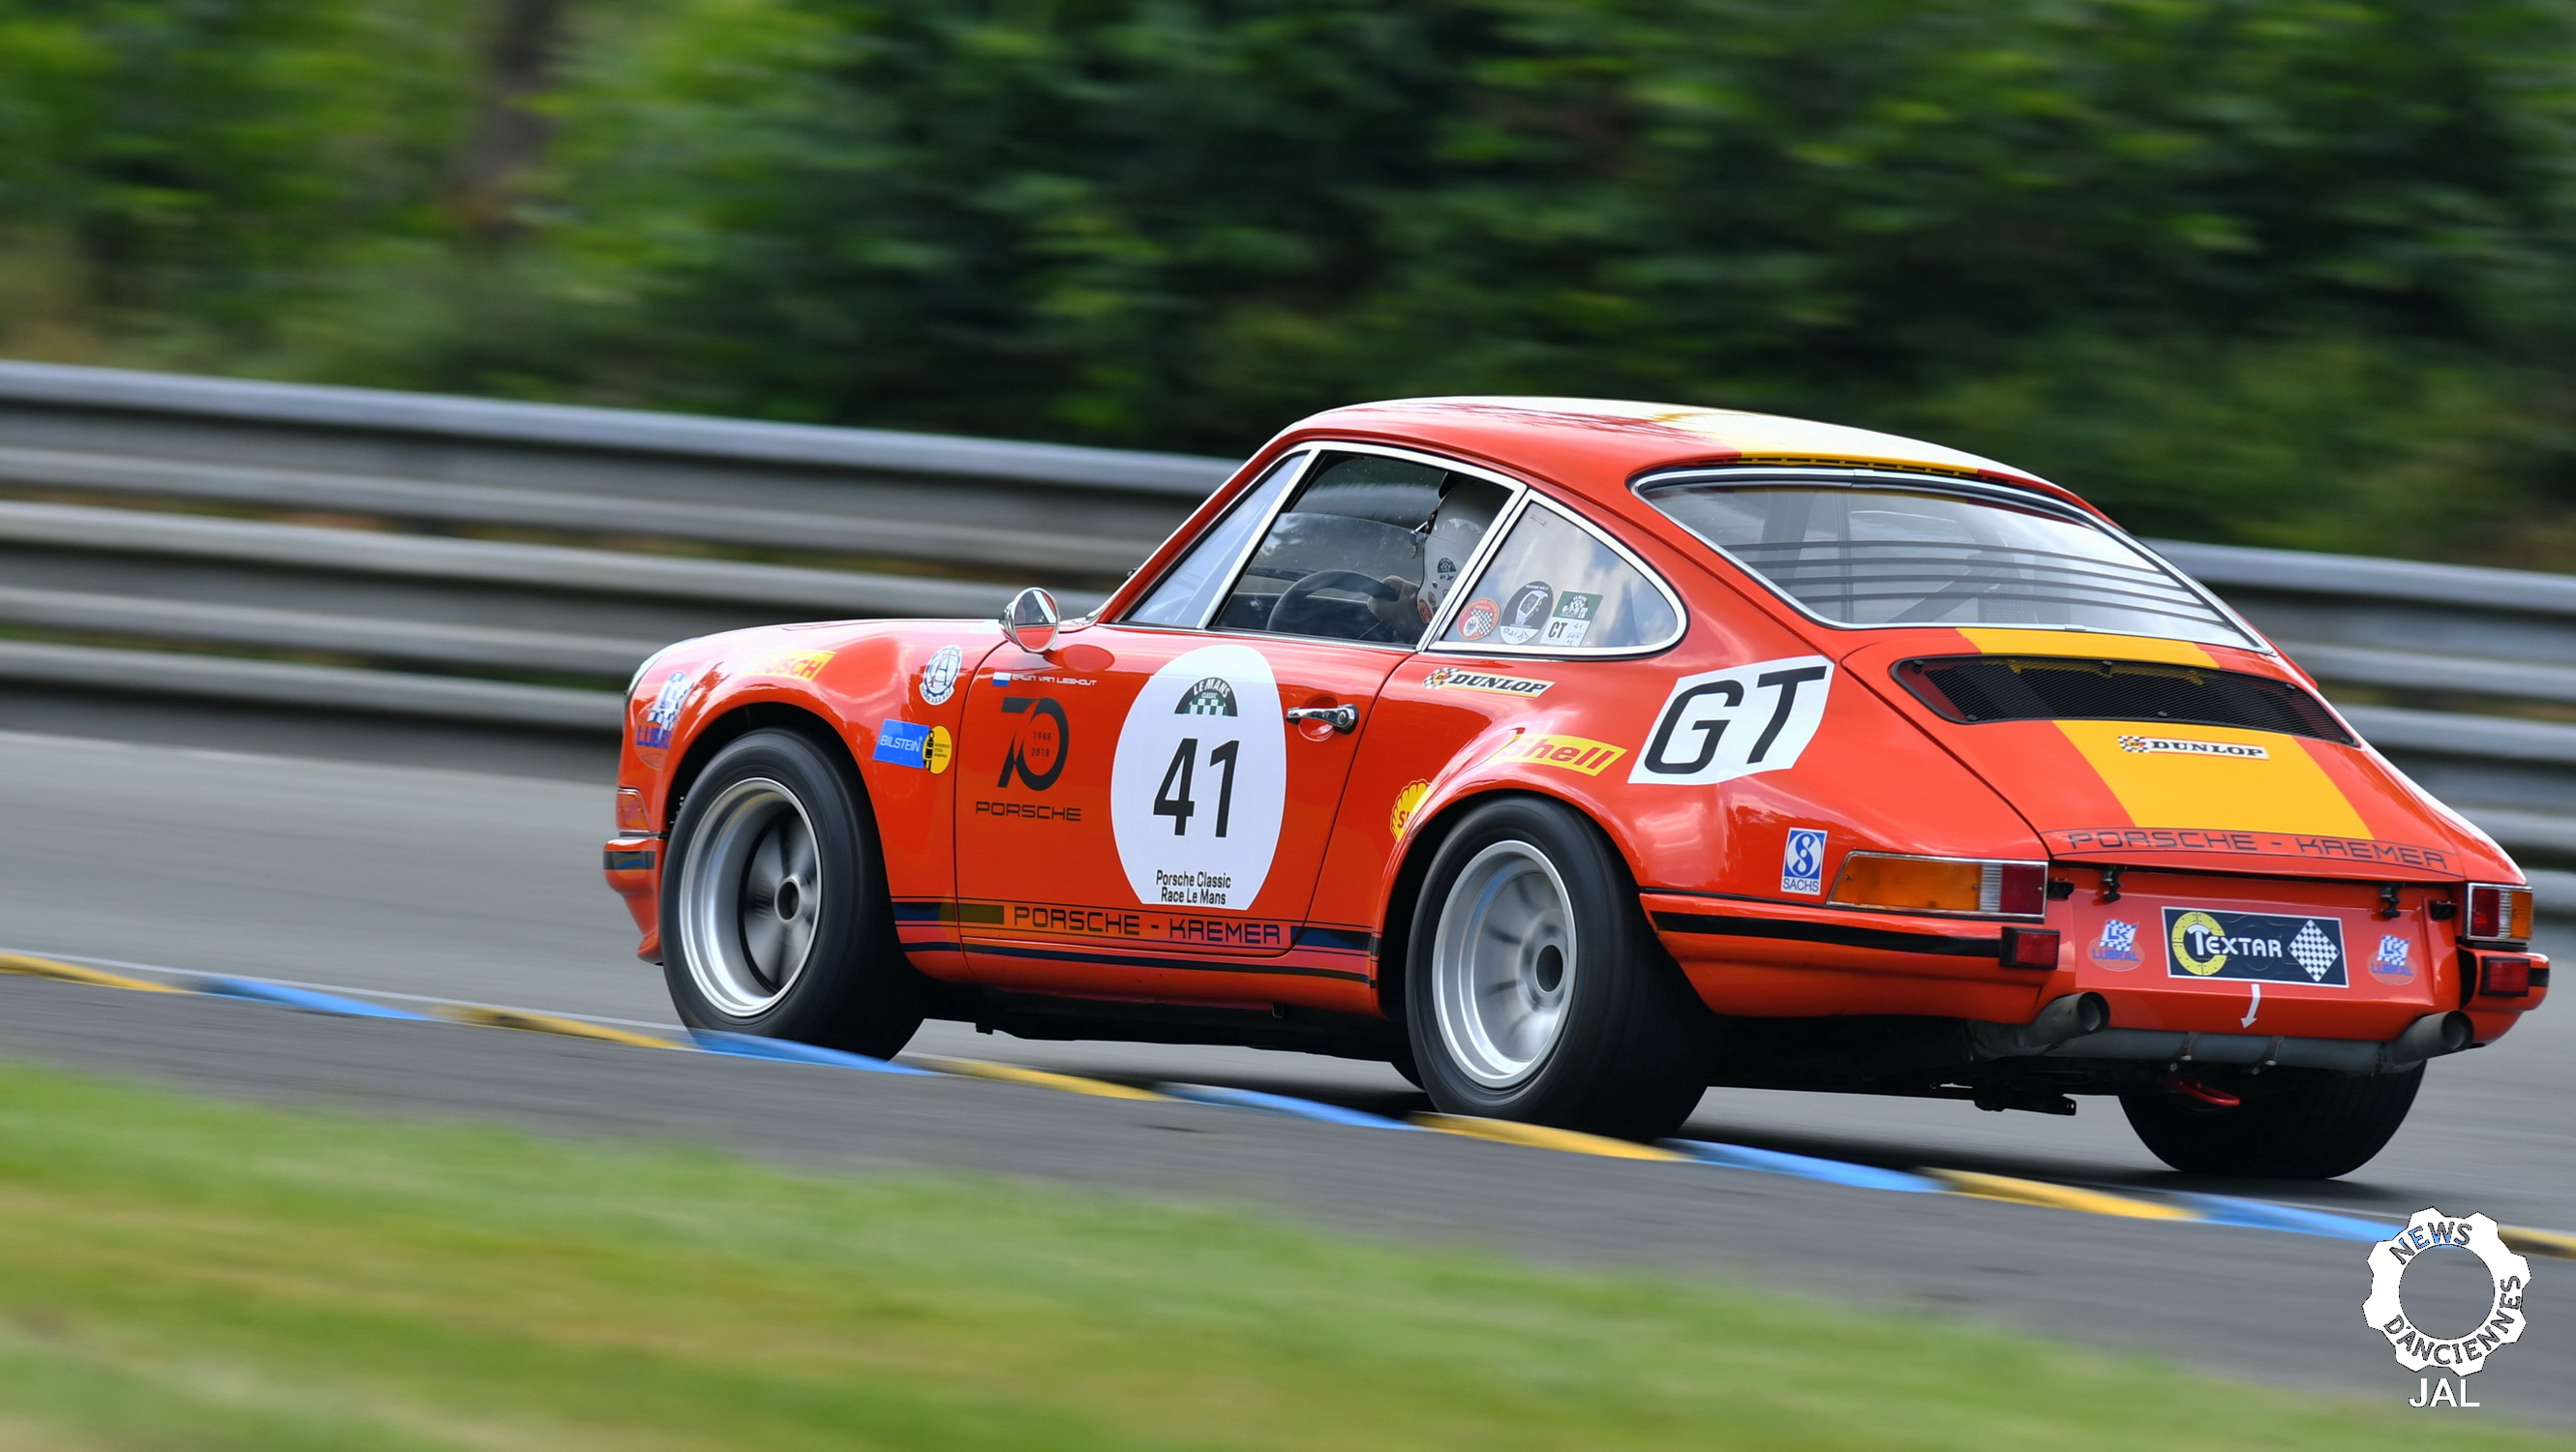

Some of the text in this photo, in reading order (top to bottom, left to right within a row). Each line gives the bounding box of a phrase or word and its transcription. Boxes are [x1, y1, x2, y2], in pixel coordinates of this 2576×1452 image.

[1194, 678, 1230, 699] LE MANS
[1448, 674, 1548, 693] DUNLOP
[1644, 665, 1828, 775] GT
[880, 735, 922, 752] BILSTEIN
[997, 696, 1070, 792] 70
[1032, 732, 1052, 741] 1948
[1031, 747, 1050, 758] 2018
[1499, 737, 1616, 771] Shell
[2150, 741, 2264, 756] DUNLOP
[1153, 738, 1240, 838] 41
[975, 801, 1082, 822] PORSCHE
[2067, 831, 2258, 851] PORSCHE
[2295, 837, 2448, 870] KREMER
[1156, 869, 1231, 889] Porsche Classic
[1782, 877, 1820, 892] SACHS
[1161, 886, 1227, 905] Race Le Mans
[1014, 905, 1140, 936] PORSCHE
[1169, 918, 1281, 945] KREMER
[2187, 923, 2284, 958] TEXTAR
